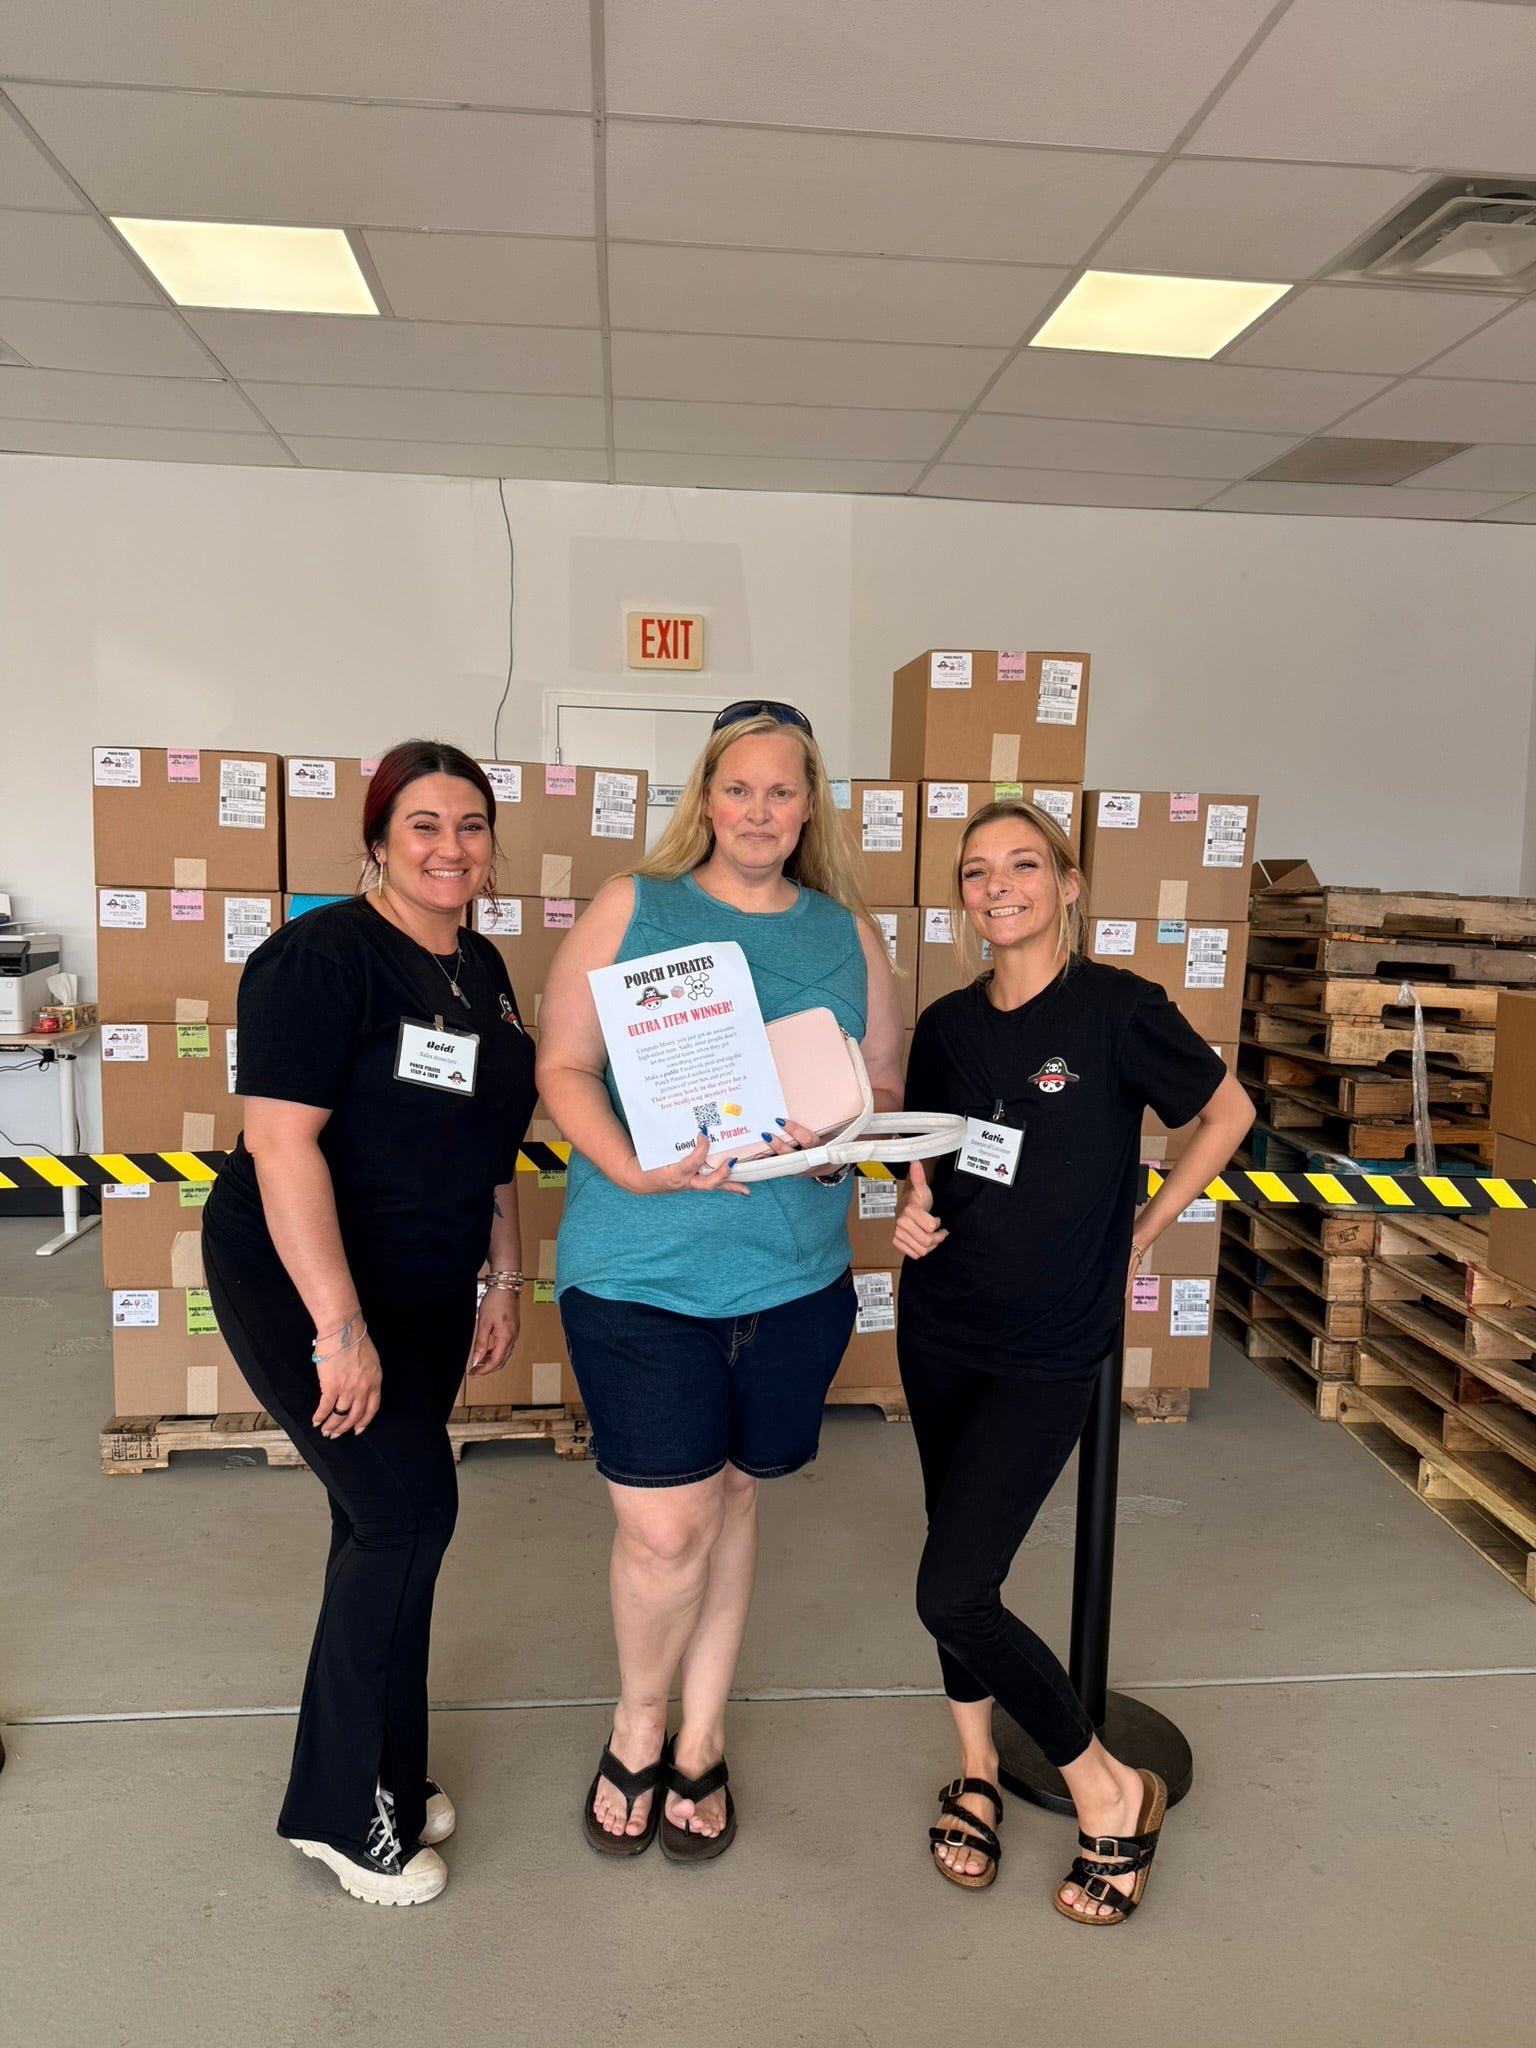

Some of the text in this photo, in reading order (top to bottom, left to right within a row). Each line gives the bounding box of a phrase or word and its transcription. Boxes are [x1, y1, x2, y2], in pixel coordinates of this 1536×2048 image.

[641, 618, 693, 660] EXIT
[624, 955, 714, 989] PORCH PIRATES
[628, 1000, 734, 1037] ULTRA ITEM WINNER!
[426, 1041, 455, 1054] Heidi
[674, 1138, 696, 1151] Good
[719, 1123, 751, 1140] Pirates.
[981, 1130, 1005, 1144] Katie
